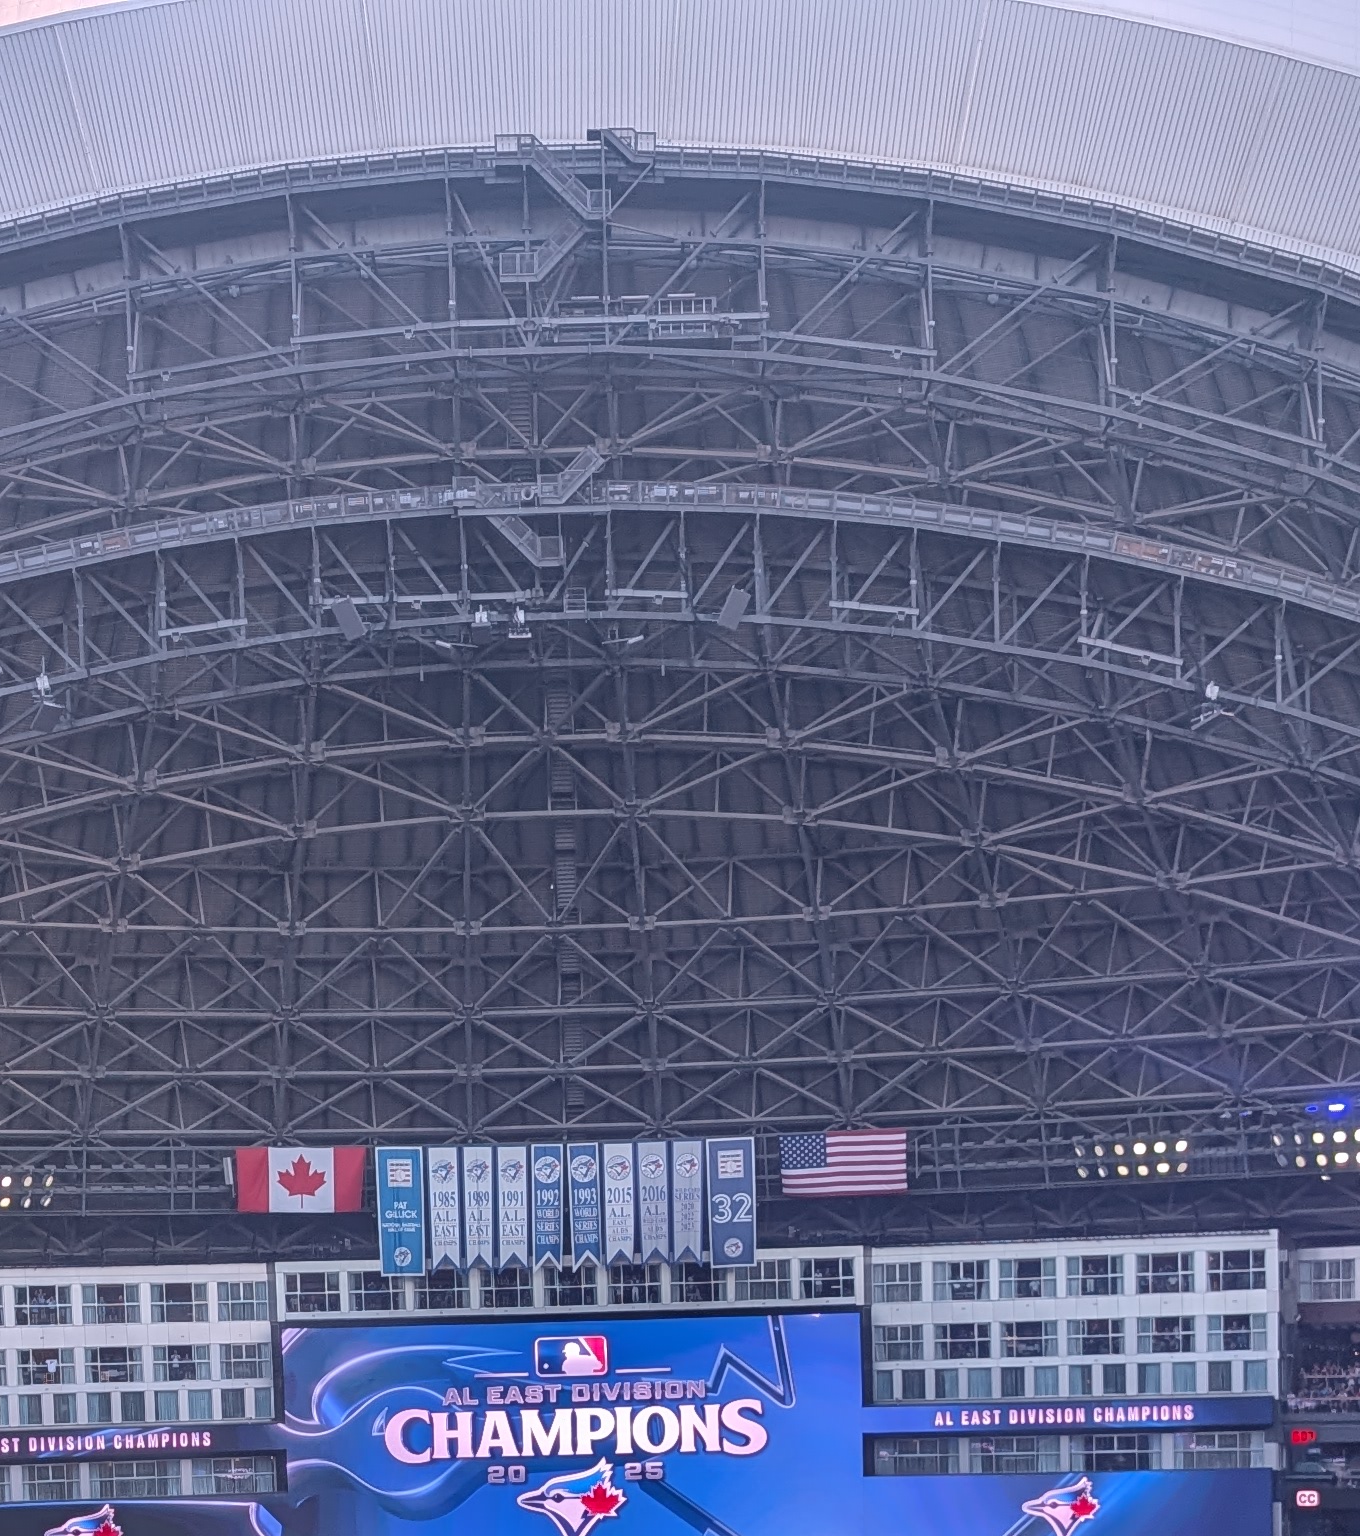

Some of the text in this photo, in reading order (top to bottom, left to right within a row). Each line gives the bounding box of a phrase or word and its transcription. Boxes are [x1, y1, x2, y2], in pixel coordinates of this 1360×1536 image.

[433, 1191, 456, 1207] 1985
[468, 1191, 489, 1207] 1989
[502, 1191, 524, 1207] 1991
[536, 1189, 559, 1206] 1992
[573, 1188, 597, 1205] 1993
[607, 1187, 632, 1204] 2015
[642, 1185, 666, 1202] 2016
[712, 1193, 752, 1224] 32
[502, 1224, 525, 1237] EAST
[443, 1380, 706, 1406] AL EAST DIVISION
[934, 1405, 1194, 1426] AL EAST DIVISION CHAMPIONS
[384, 1398, 768, 1465] CHAMPIONS
[29, 1434, 106, 1453] DIVISION
[113, 1431, 212, 1450] CHAMPIONS
[487, 1461, 664, 1484] 20 25
